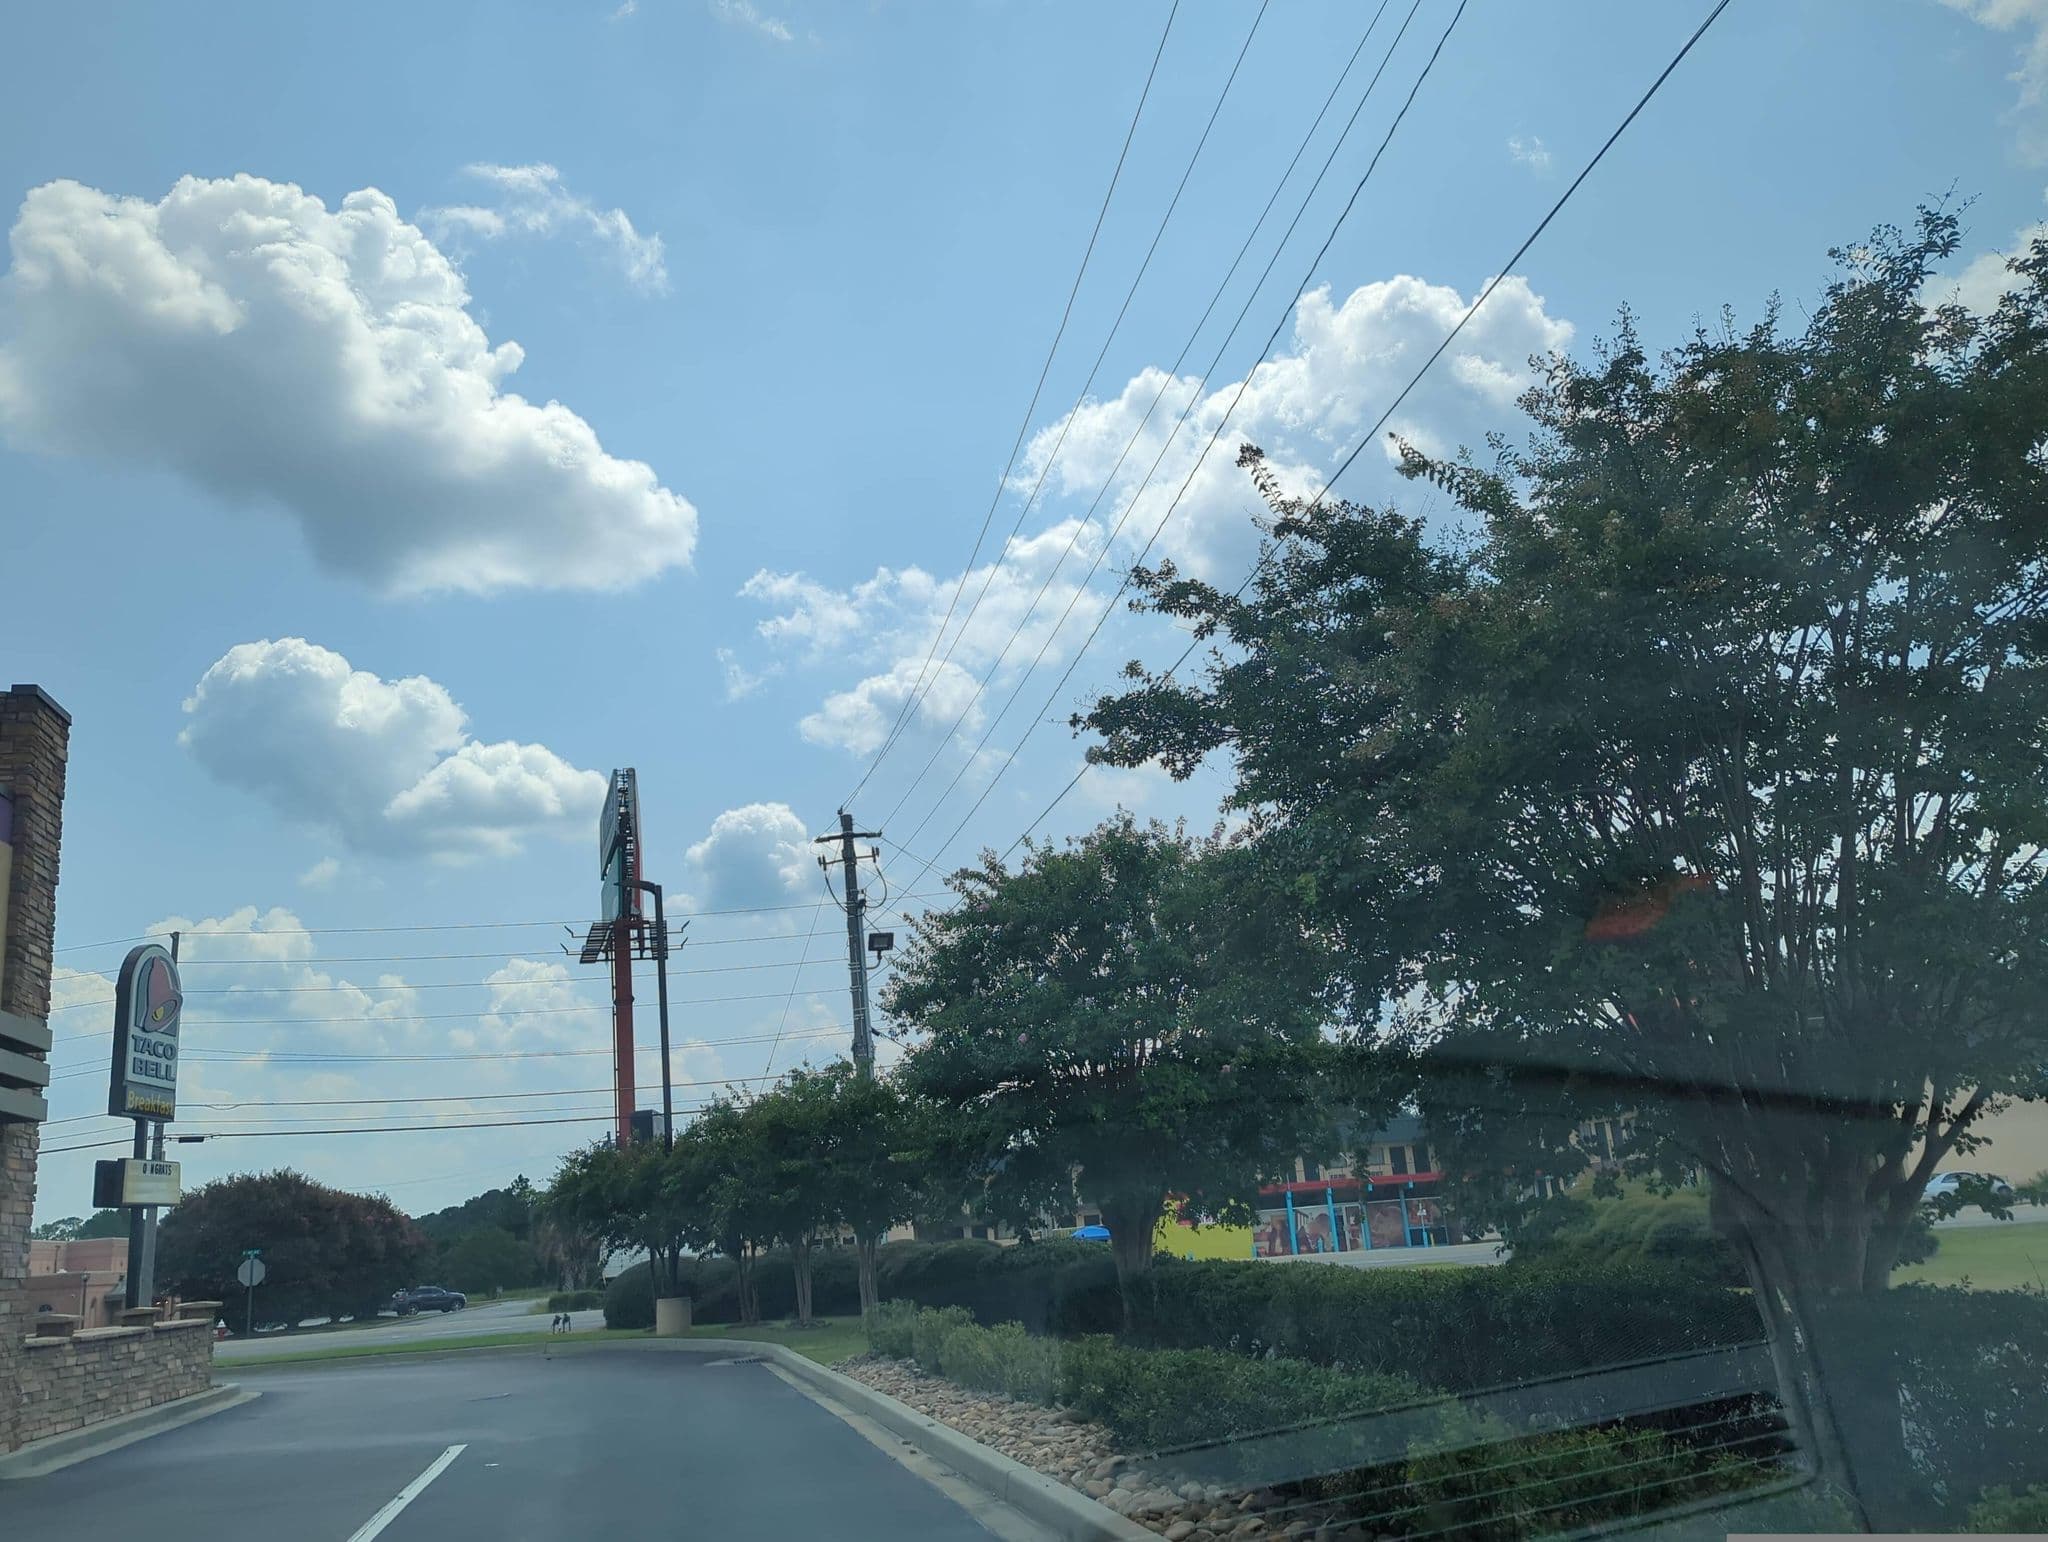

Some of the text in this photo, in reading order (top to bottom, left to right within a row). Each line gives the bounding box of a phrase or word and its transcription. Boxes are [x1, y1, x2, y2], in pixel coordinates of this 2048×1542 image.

[131, 1034, 177, 1060] TACO
[132, 1056, 176, 1082] BELL
[128, 1090, 174, 1116] Breakfast
